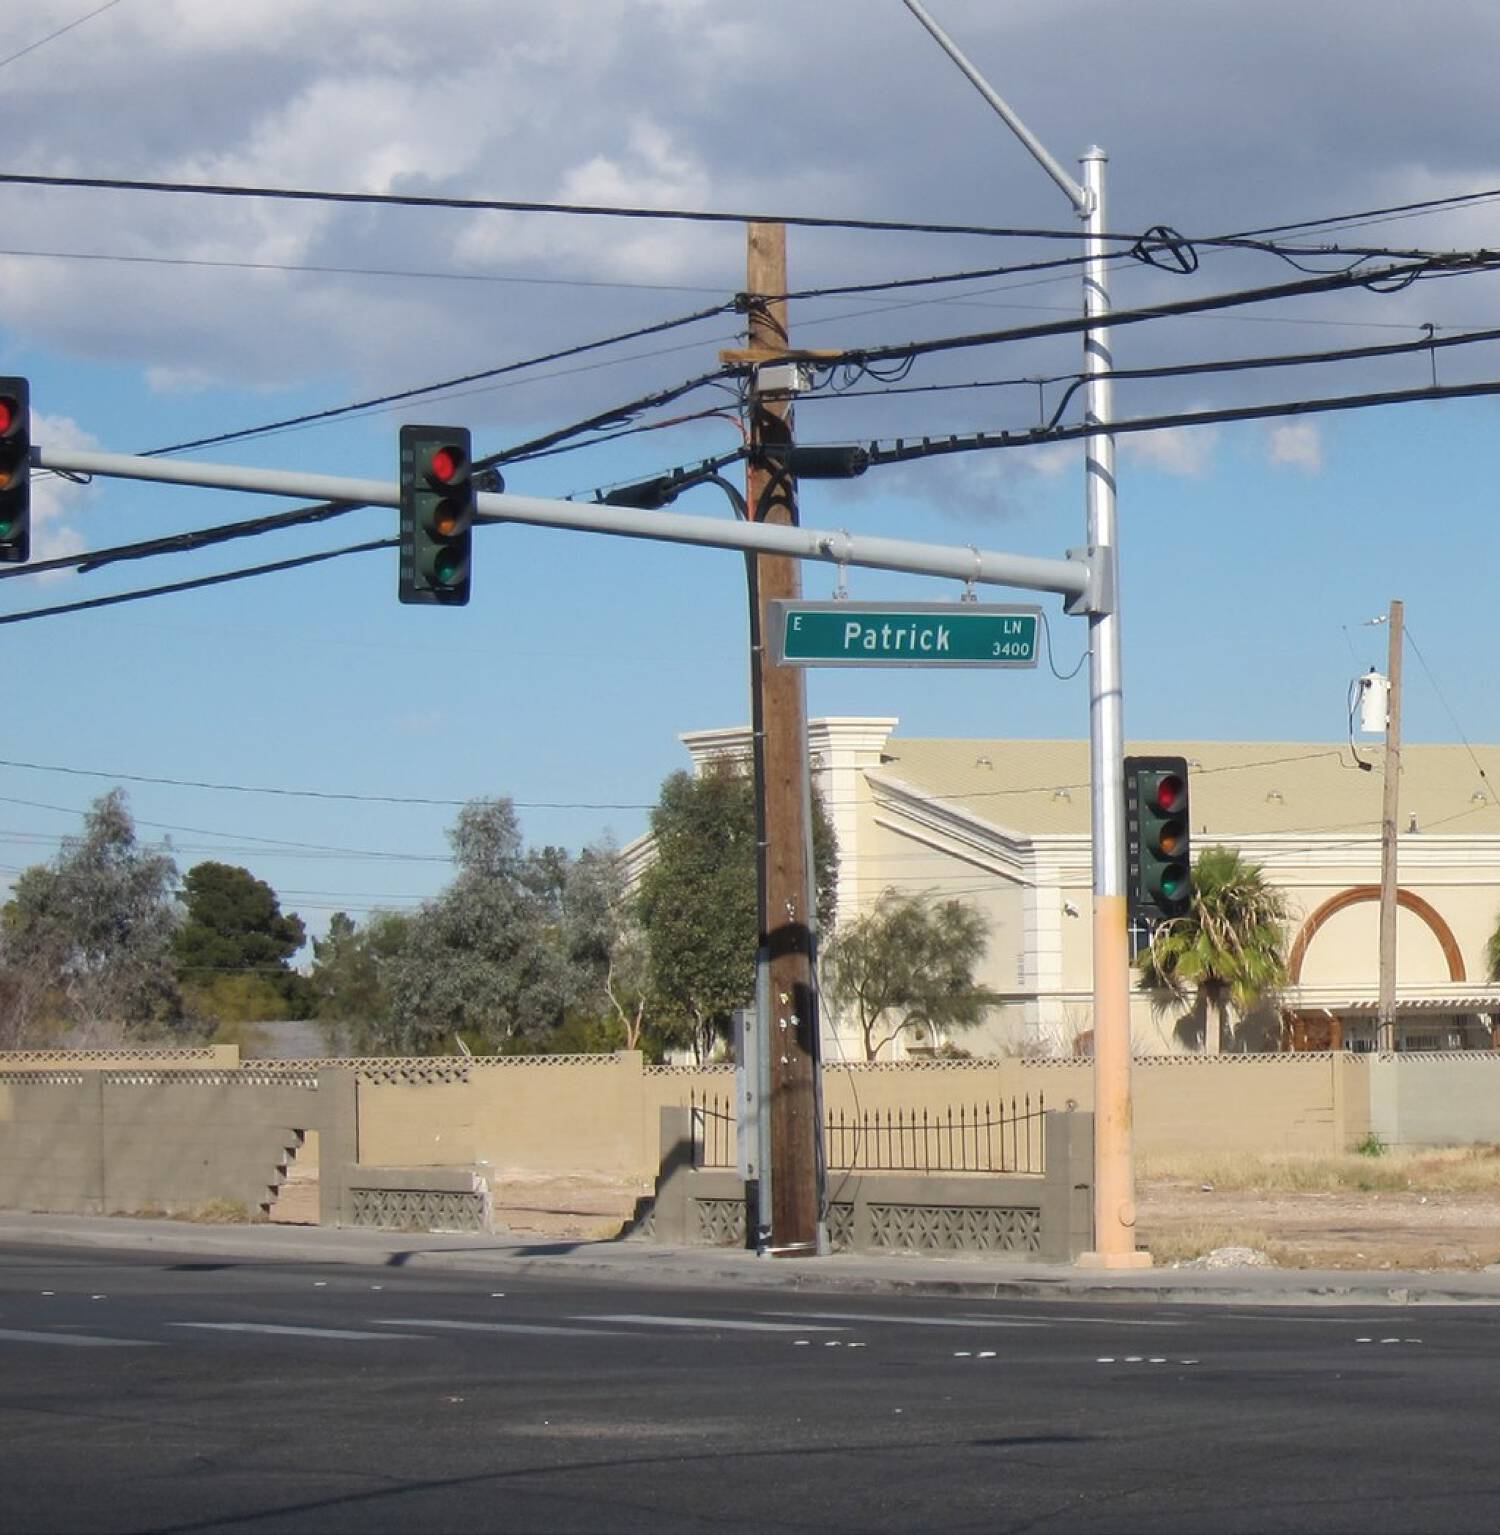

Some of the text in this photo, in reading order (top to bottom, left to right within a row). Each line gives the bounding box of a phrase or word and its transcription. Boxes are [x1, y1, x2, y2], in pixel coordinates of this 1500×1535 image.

[793, 616, 1022, 651] E Patrick LN
[992, 642, 1029, 657] 3400
